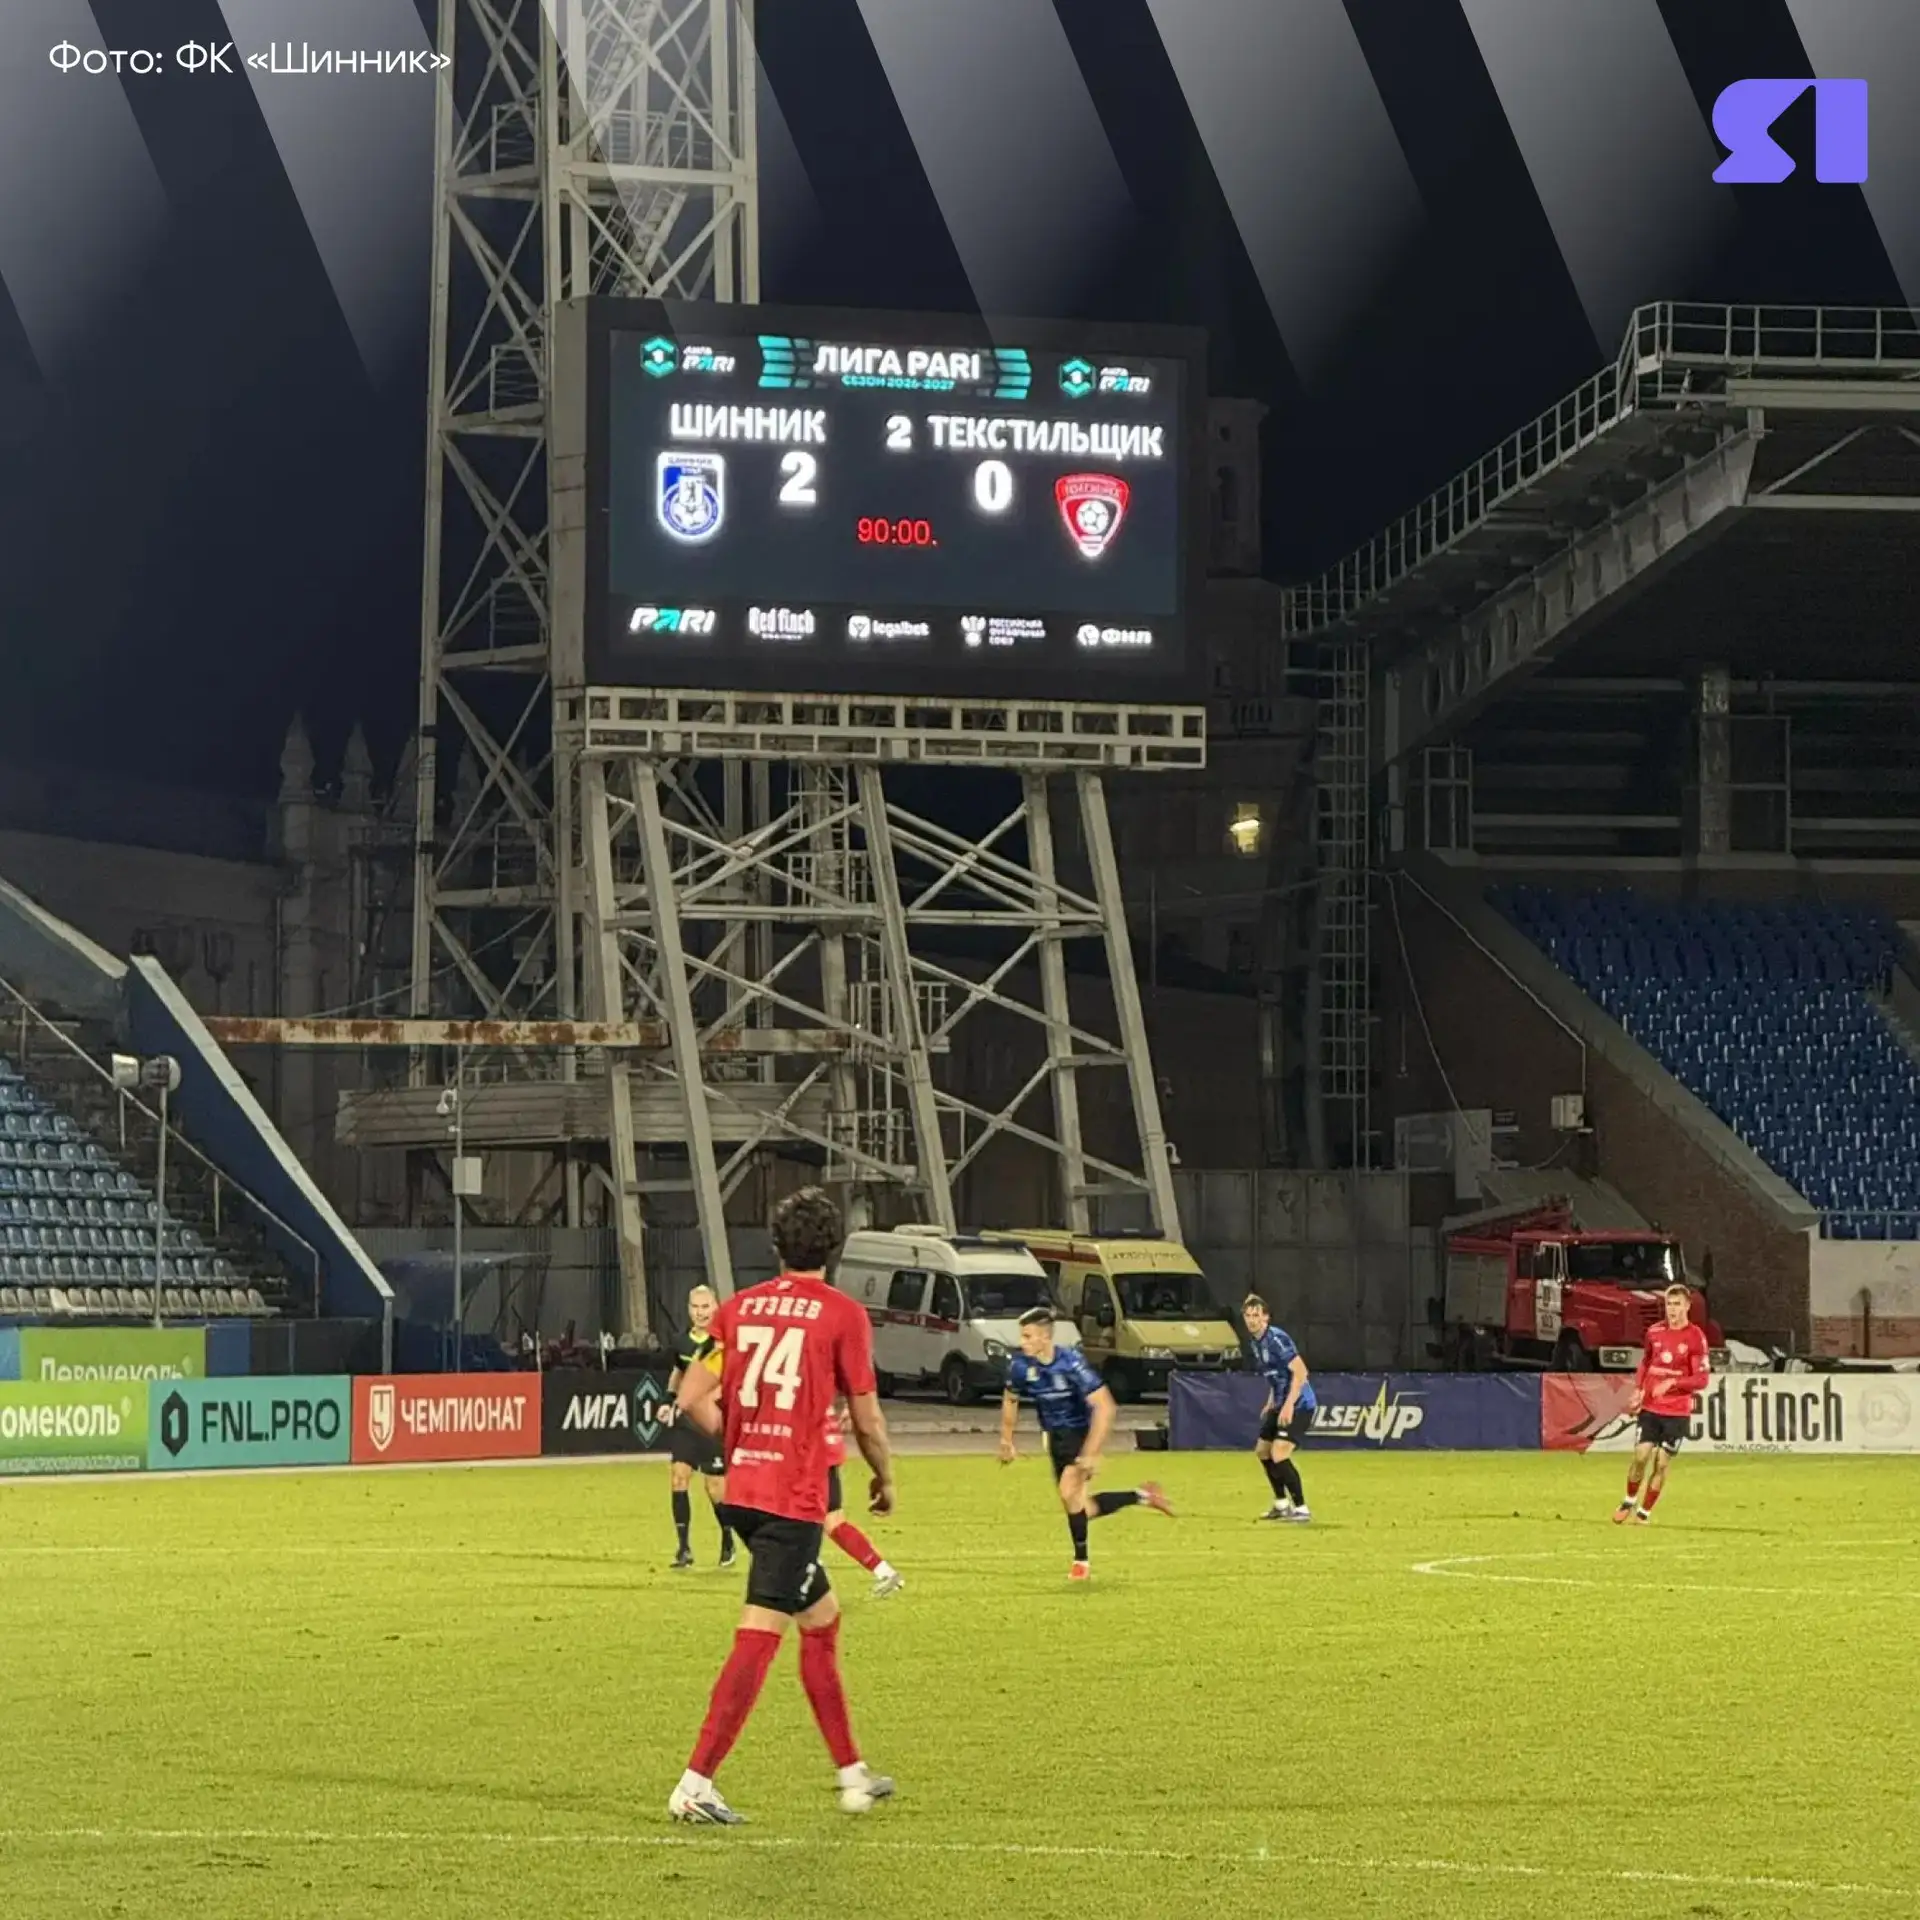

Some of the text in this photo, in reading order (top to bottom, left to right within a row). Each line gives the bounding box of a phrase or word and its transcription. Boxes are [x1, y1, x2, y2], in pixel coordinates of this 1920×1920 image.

[682, 355, 737, 372] PARI
[812, 345, 980, 380] ЛИГА PARI
[841, 374, 886, 388] СЕЗОН
[1099, 375, 1151, 393] PARI
[669, 403, 827, 443] ШИННИК
[885, 415, 1165, 461] 2 ТЕКСТИЛЬЩИК
[778, 451, 817, 504] 2
[974, 459, 1013, 512] 0
[630, 606, 716, 634] PARI
[748, 606, 816, 635] Red finch
[736, 1325, 806, 1411] 74
[0, 1403, 121, 1439] омеколь
[202, 1398, 341, 1444] FNL.PRO
[400, 1396, 527, 1434] ЧЕМПИОНАТ
[562, 1393, 629, 1430] ЛИГА
[1688, 1377, 1727, 1442] ed
[1741, 1376, 1843, 1442] finch
